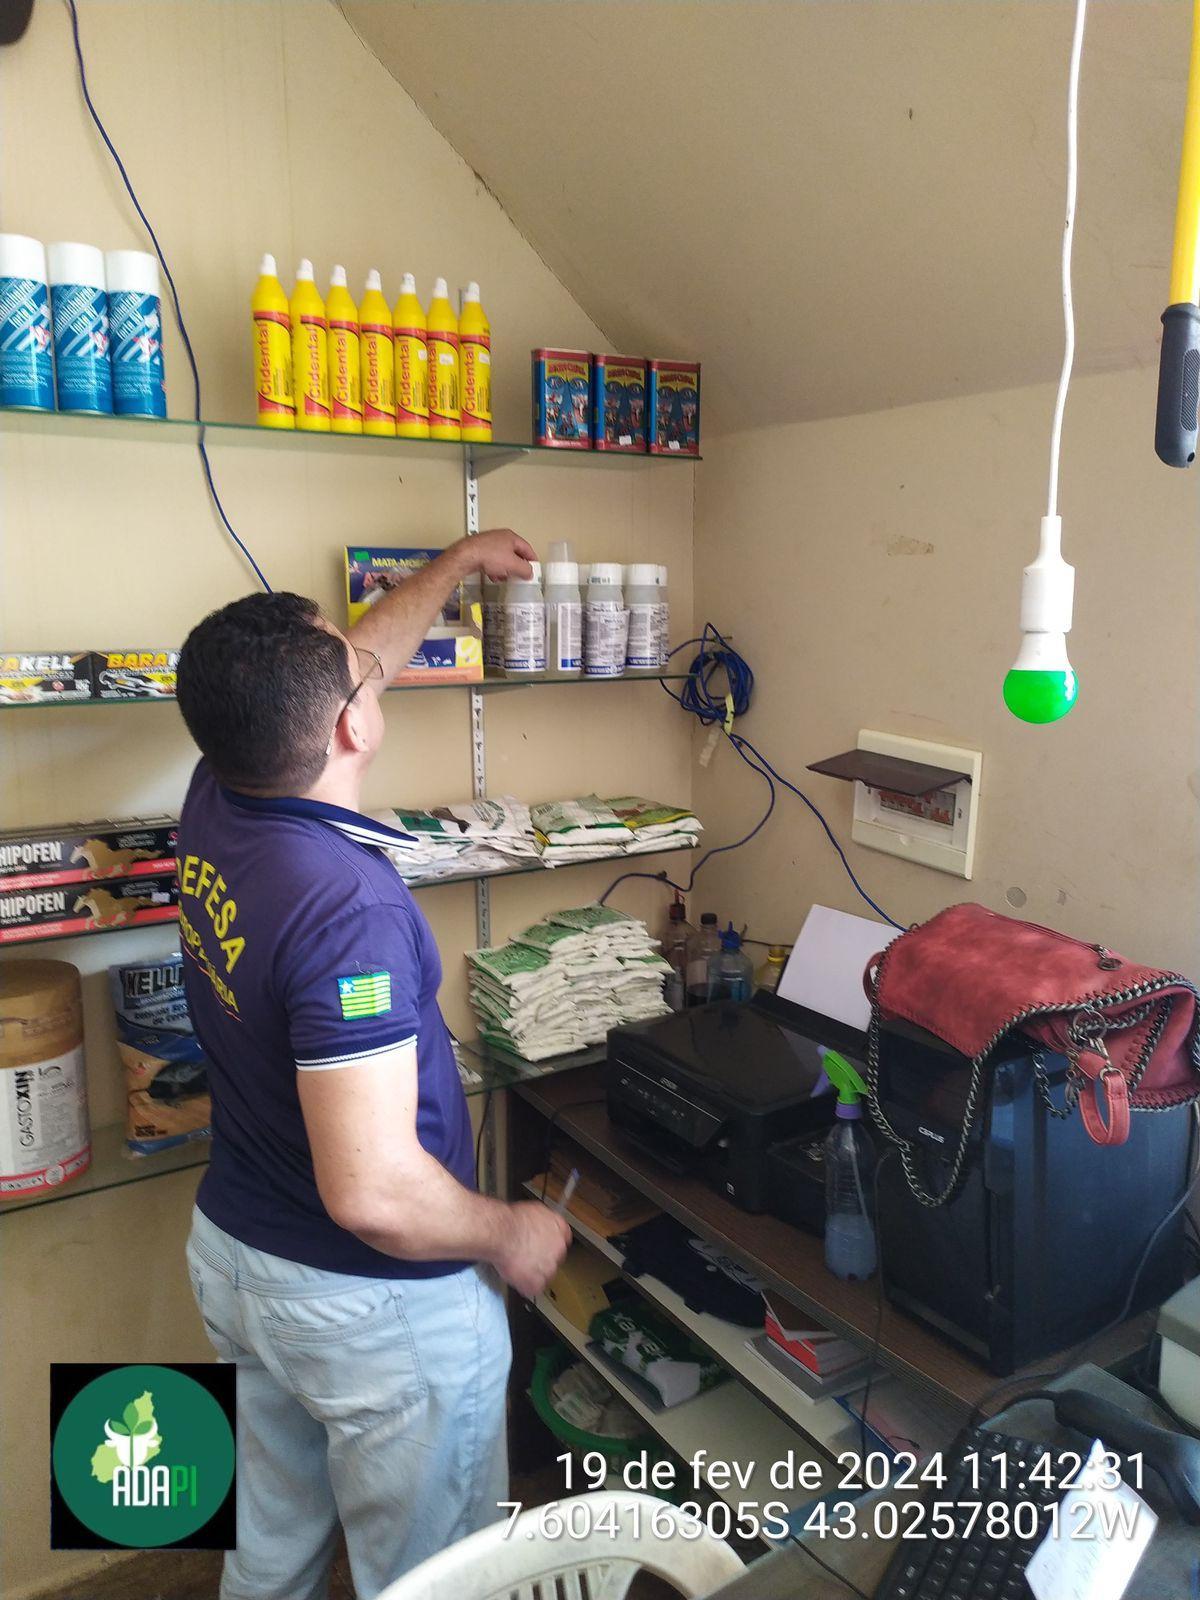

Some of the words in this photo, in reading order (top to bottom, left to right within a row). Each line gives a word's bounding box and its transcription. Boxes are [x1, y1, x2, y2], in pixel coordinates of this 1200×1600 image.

[257, 322, 272, 395] Cidental
[306, 326, 320, 398] Cidental
[334, 331, 349, 402] Cidental
[365, 334, 379, 403] Cidental
[399, 339, 411, 406] Cidental
[427, 341, 438, 410] Cidental
[464, 345, 475, 412] Cidental
[0, 655, 75, 672] AKELL
[176, 855, 246, 974] EFESA
[15, 1070, 35, 1147] GASTOXIN
